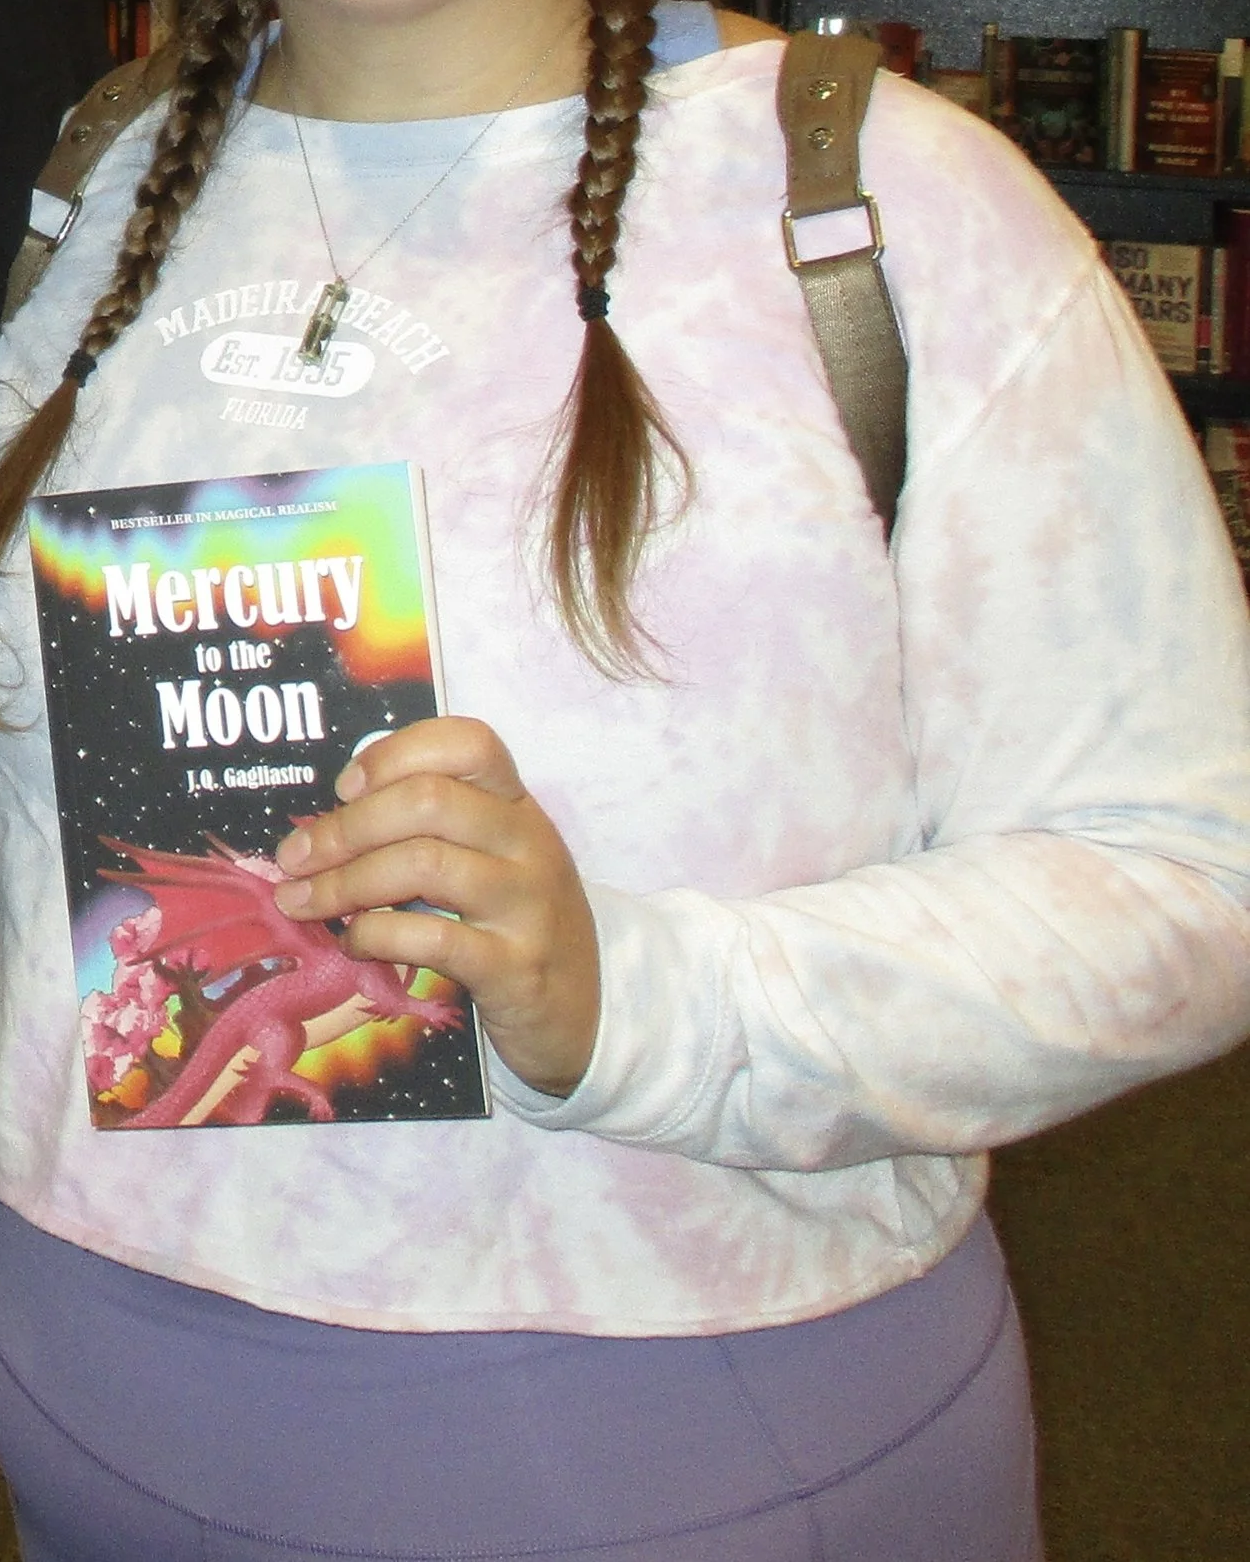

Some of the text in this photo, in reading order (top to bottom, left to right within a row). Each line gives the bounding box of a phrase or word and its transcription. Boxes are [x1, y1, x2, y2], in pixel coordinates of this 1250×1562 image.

[1113, 244, 1149, 270] SO
[154, 280, 450, 375] MADEIRA BEACH
[219, 397, 309, 431] FLORIDA
[111, 500, 338, 530] BESTSELLER IN MAGICAL REALISM
[101, 555, 363, 637] Mercury
[195, 640, 273, 674] to the
[155, 679, 325, 750] Moon
[186, 763, 315, 793] J.Q. Gagliastro
